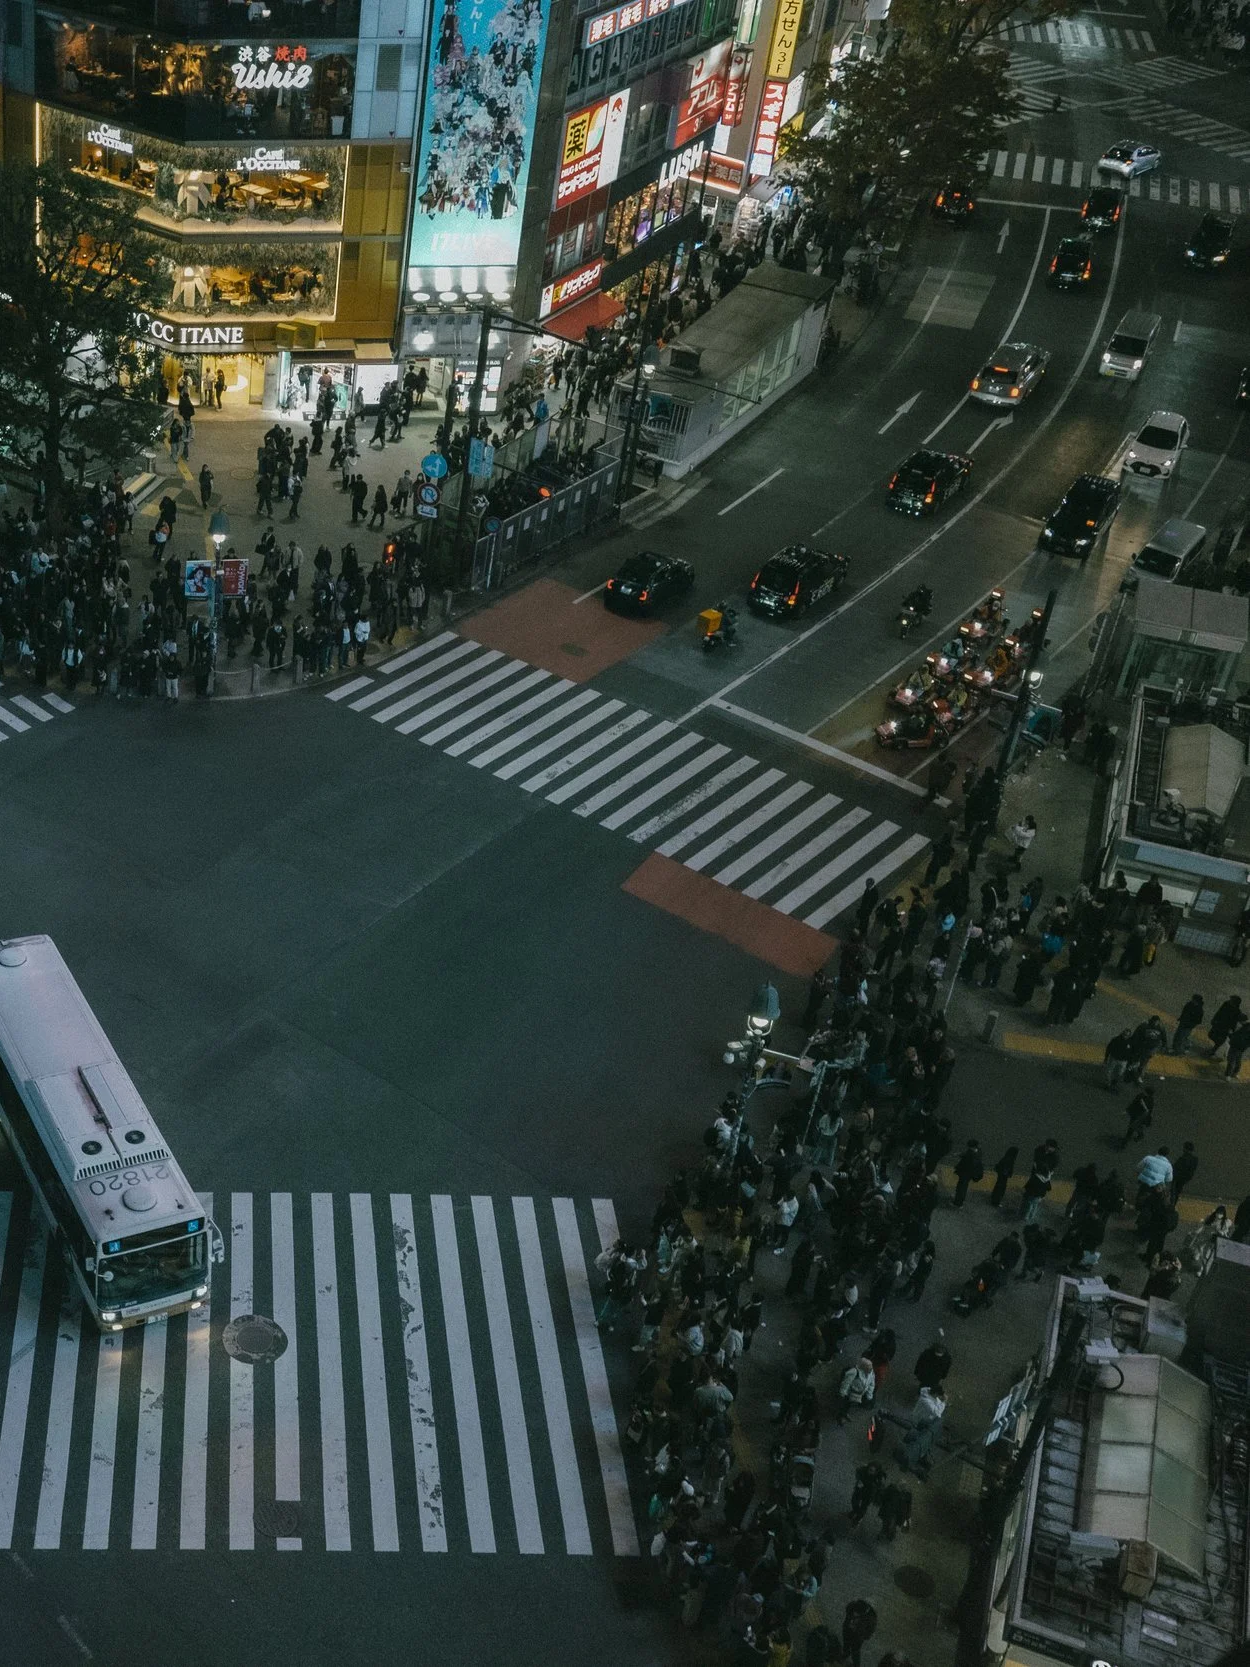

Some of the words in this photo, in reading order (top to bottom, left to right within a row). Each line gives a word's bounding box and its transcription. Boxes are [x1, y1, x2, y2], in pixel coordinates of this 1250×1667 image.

[238, 46, 272, 64] 渋谷
[274, 44, 308, 62] 焼肉
[231, 62, 313, 89] Ushi8
[686, 79, 718, 115] アコム
[724, 82, 739, 112] アコム
[566, 118, 588, 161] 薬
[658, 140, 704, 190] LUSH
[558, 165, 600, 200] サンドラッグ
[89, 1164, 169, 1197] 21820
